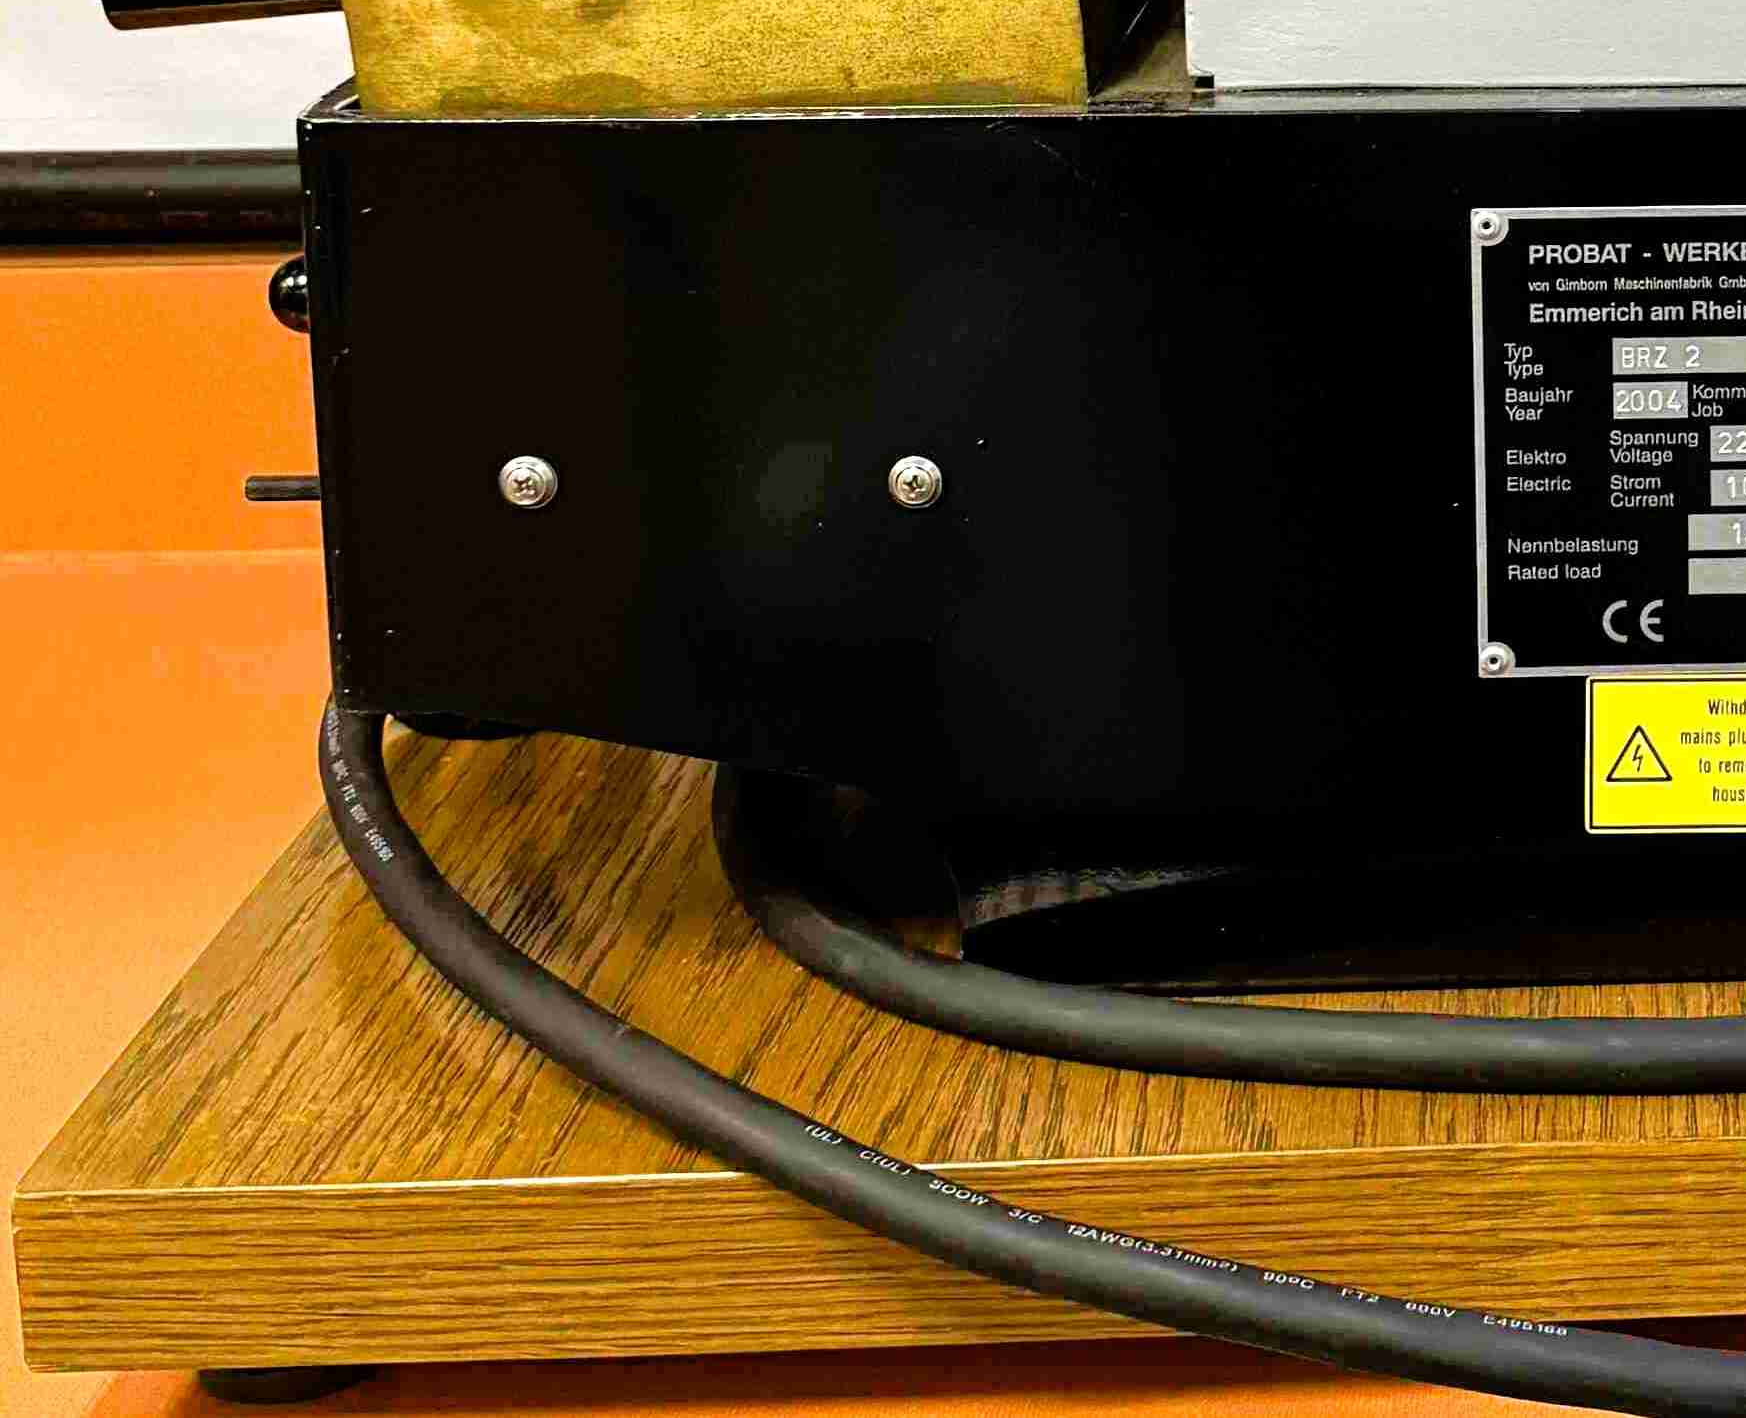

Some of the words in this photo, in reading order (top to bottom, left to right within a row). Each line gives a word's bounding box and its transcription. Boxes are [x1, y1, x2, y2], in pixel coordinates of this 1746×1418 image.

[1528, 243, 1632, 265] PROBAT
[1528, 280, 1550, 292] von
[1614, 276, 1713, 291] Maschinenfabrik
[1529, 302, 1643, 323] Emmerich
[1650, 305, 1684, 321] am
[1504, 343, 1533, 362] Typ
[1621, 345, 1668, 369] BRZ
[1685, 345, 1701, 368] 2
[1504, 361, 1544, 380] Type
[1504, 387, 1574, 405] Baujahr
[1616, 388, 1683, 413] 2004
[1504, 405, 1544, 421] Year
[1691, 402, 1724, 418] Job
[1609, 429, 1699, 448] Spannung
[1506, 449, 1567, 465] Elektro
[1609, 448, 1673, 467] Voltage
[1506, 475, 1572, 492] Electric
[1609, 474, 1662, 490] Strom
[1609, 492, 1675, 508] Current
[1507, 537, 1639, 556] Nennbelastung
[1508, 564, 1559, 580] Rated
[1565, 563, 1601, 579] load
[1680, 728, 1721, 745] mains
[1699, 757, 1712, 774] to
[804, 1123, 843, 1146] (UL)
[858, 1148, 913, 1178] C(UL)
